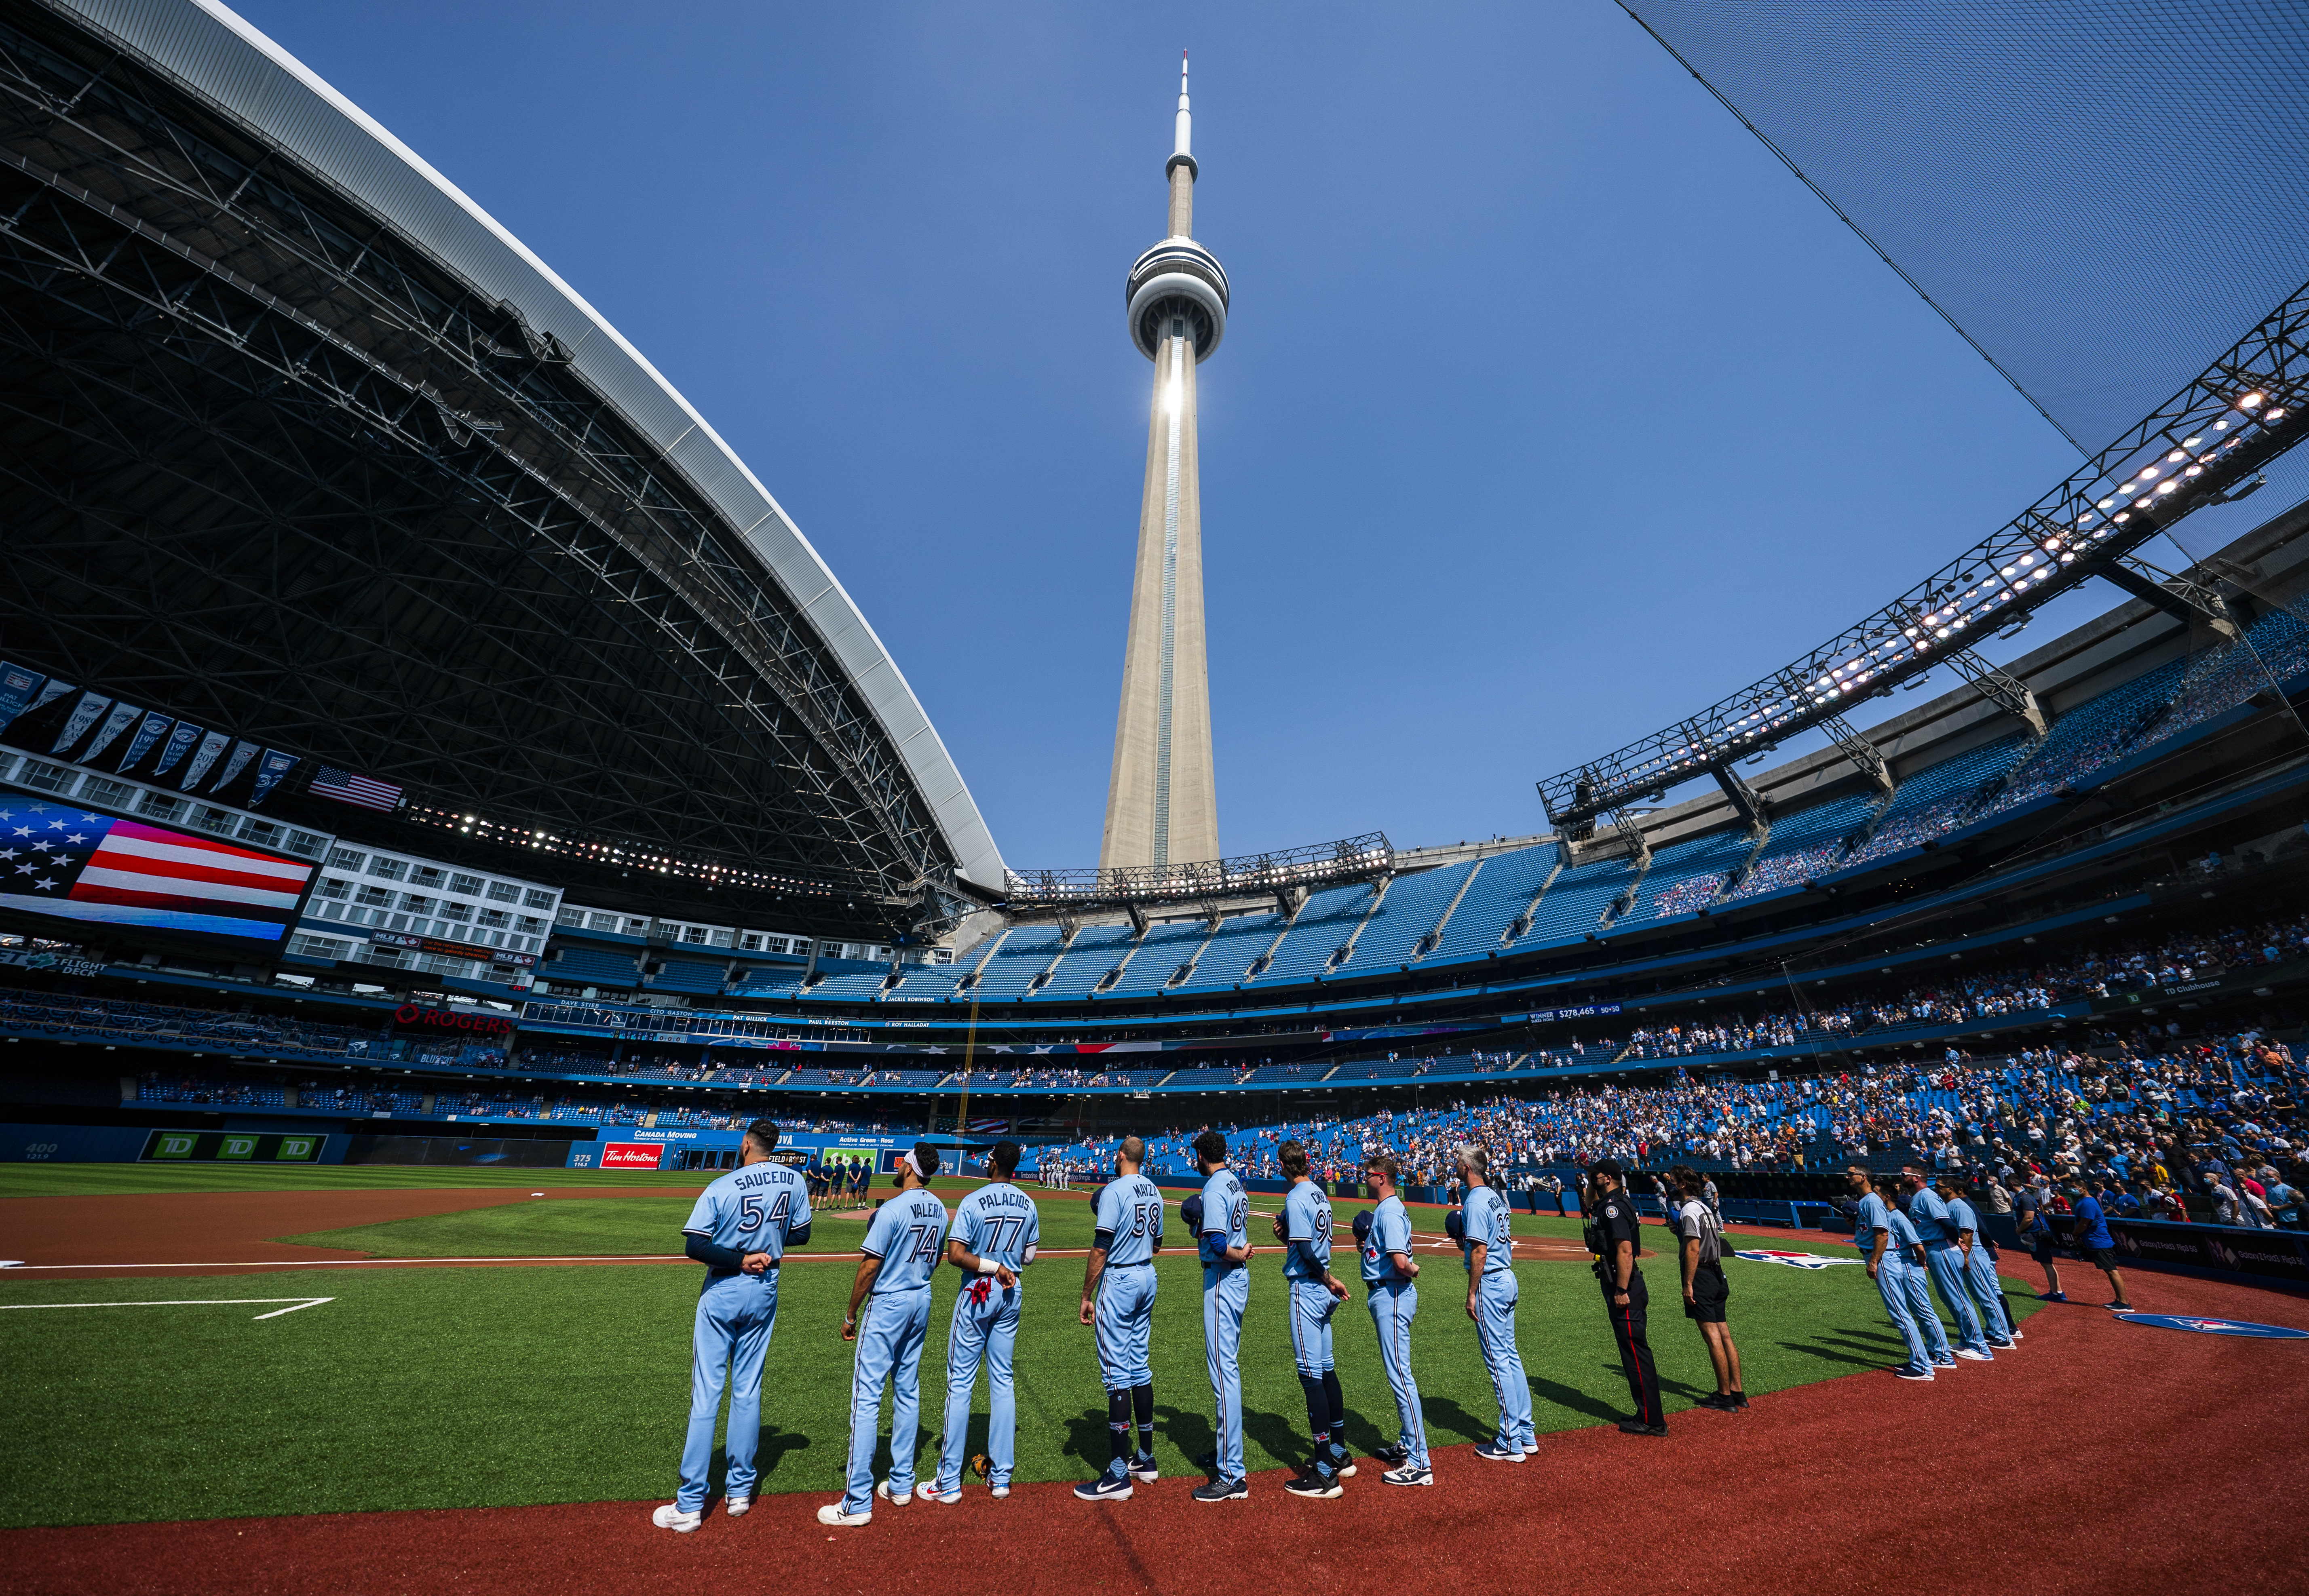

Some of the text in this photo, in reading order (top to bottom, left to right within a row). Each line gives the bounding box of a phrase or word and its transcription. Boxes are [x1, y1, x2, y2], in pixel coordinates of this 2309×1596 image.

[0, 696, 24, 707] ILLICK
[63, 729, 81, 738] EAS
[102, 725, 122, 736] 199
[138, 734, 159, 744] 199
[170, 743, 190, 752] 199
[230, 759, 246, 768] 201
[443, 942, 464, 952] ramparts
[0, 950, 28, 964] ET
[464, 951, 489, 960] streaming
[60, 959, 108, 971] FLIGHT
[62, 967, 98, 977] DECK
[2177, 980, 2220, 993] Clubhouse
[1559, 1007, 1594, 1018] $278,465
[423, 1009, 513, 1034] ROGERS
[634, 1130, 665, 1138] CANADA
[777, 1135, 792, 1145] OVA
[26, 1143, 58, 1153] 400
[164, 1138, 192, 1153] TD
[227, 1139, 253, 1155] TD
[285, 1141, 310, 1156] TD
[606, 1151, 658, 1162] Tim Hortons
[734, 1171, 794, 1191] SAUCEDO
[1133, 1184, 1159, 1198] MAYZA
[1328, 1185, 1335, 1194] TD
[1359, 1187, 1366, 1196] TD
[978, 1193, 1030, 1211] PALACIOS
[737, 1191, 791, 1234] 54
[910, 1203, 943, 1221] VALERA
[1231, 1198, 1248, 1233] 68
[1131, 1202, 1160, 1238] 58
[984, 1215, 1026, 1252] 77
[1315, 1209, 1333, 1245] 90
[1496, 1213, 1511, 1245] 33
[905, 1224, 939, 1263] 74
[2139, 1240, 2158, 1250] Galaxy
[2176, 1244, 2189, 1253] Flip3
[2238, 1250, 2260, 1262] Galaxy
[2263, 1253, 2280, 1262] Fold3
[2281, 1255, 2296, 1266] Flip3
